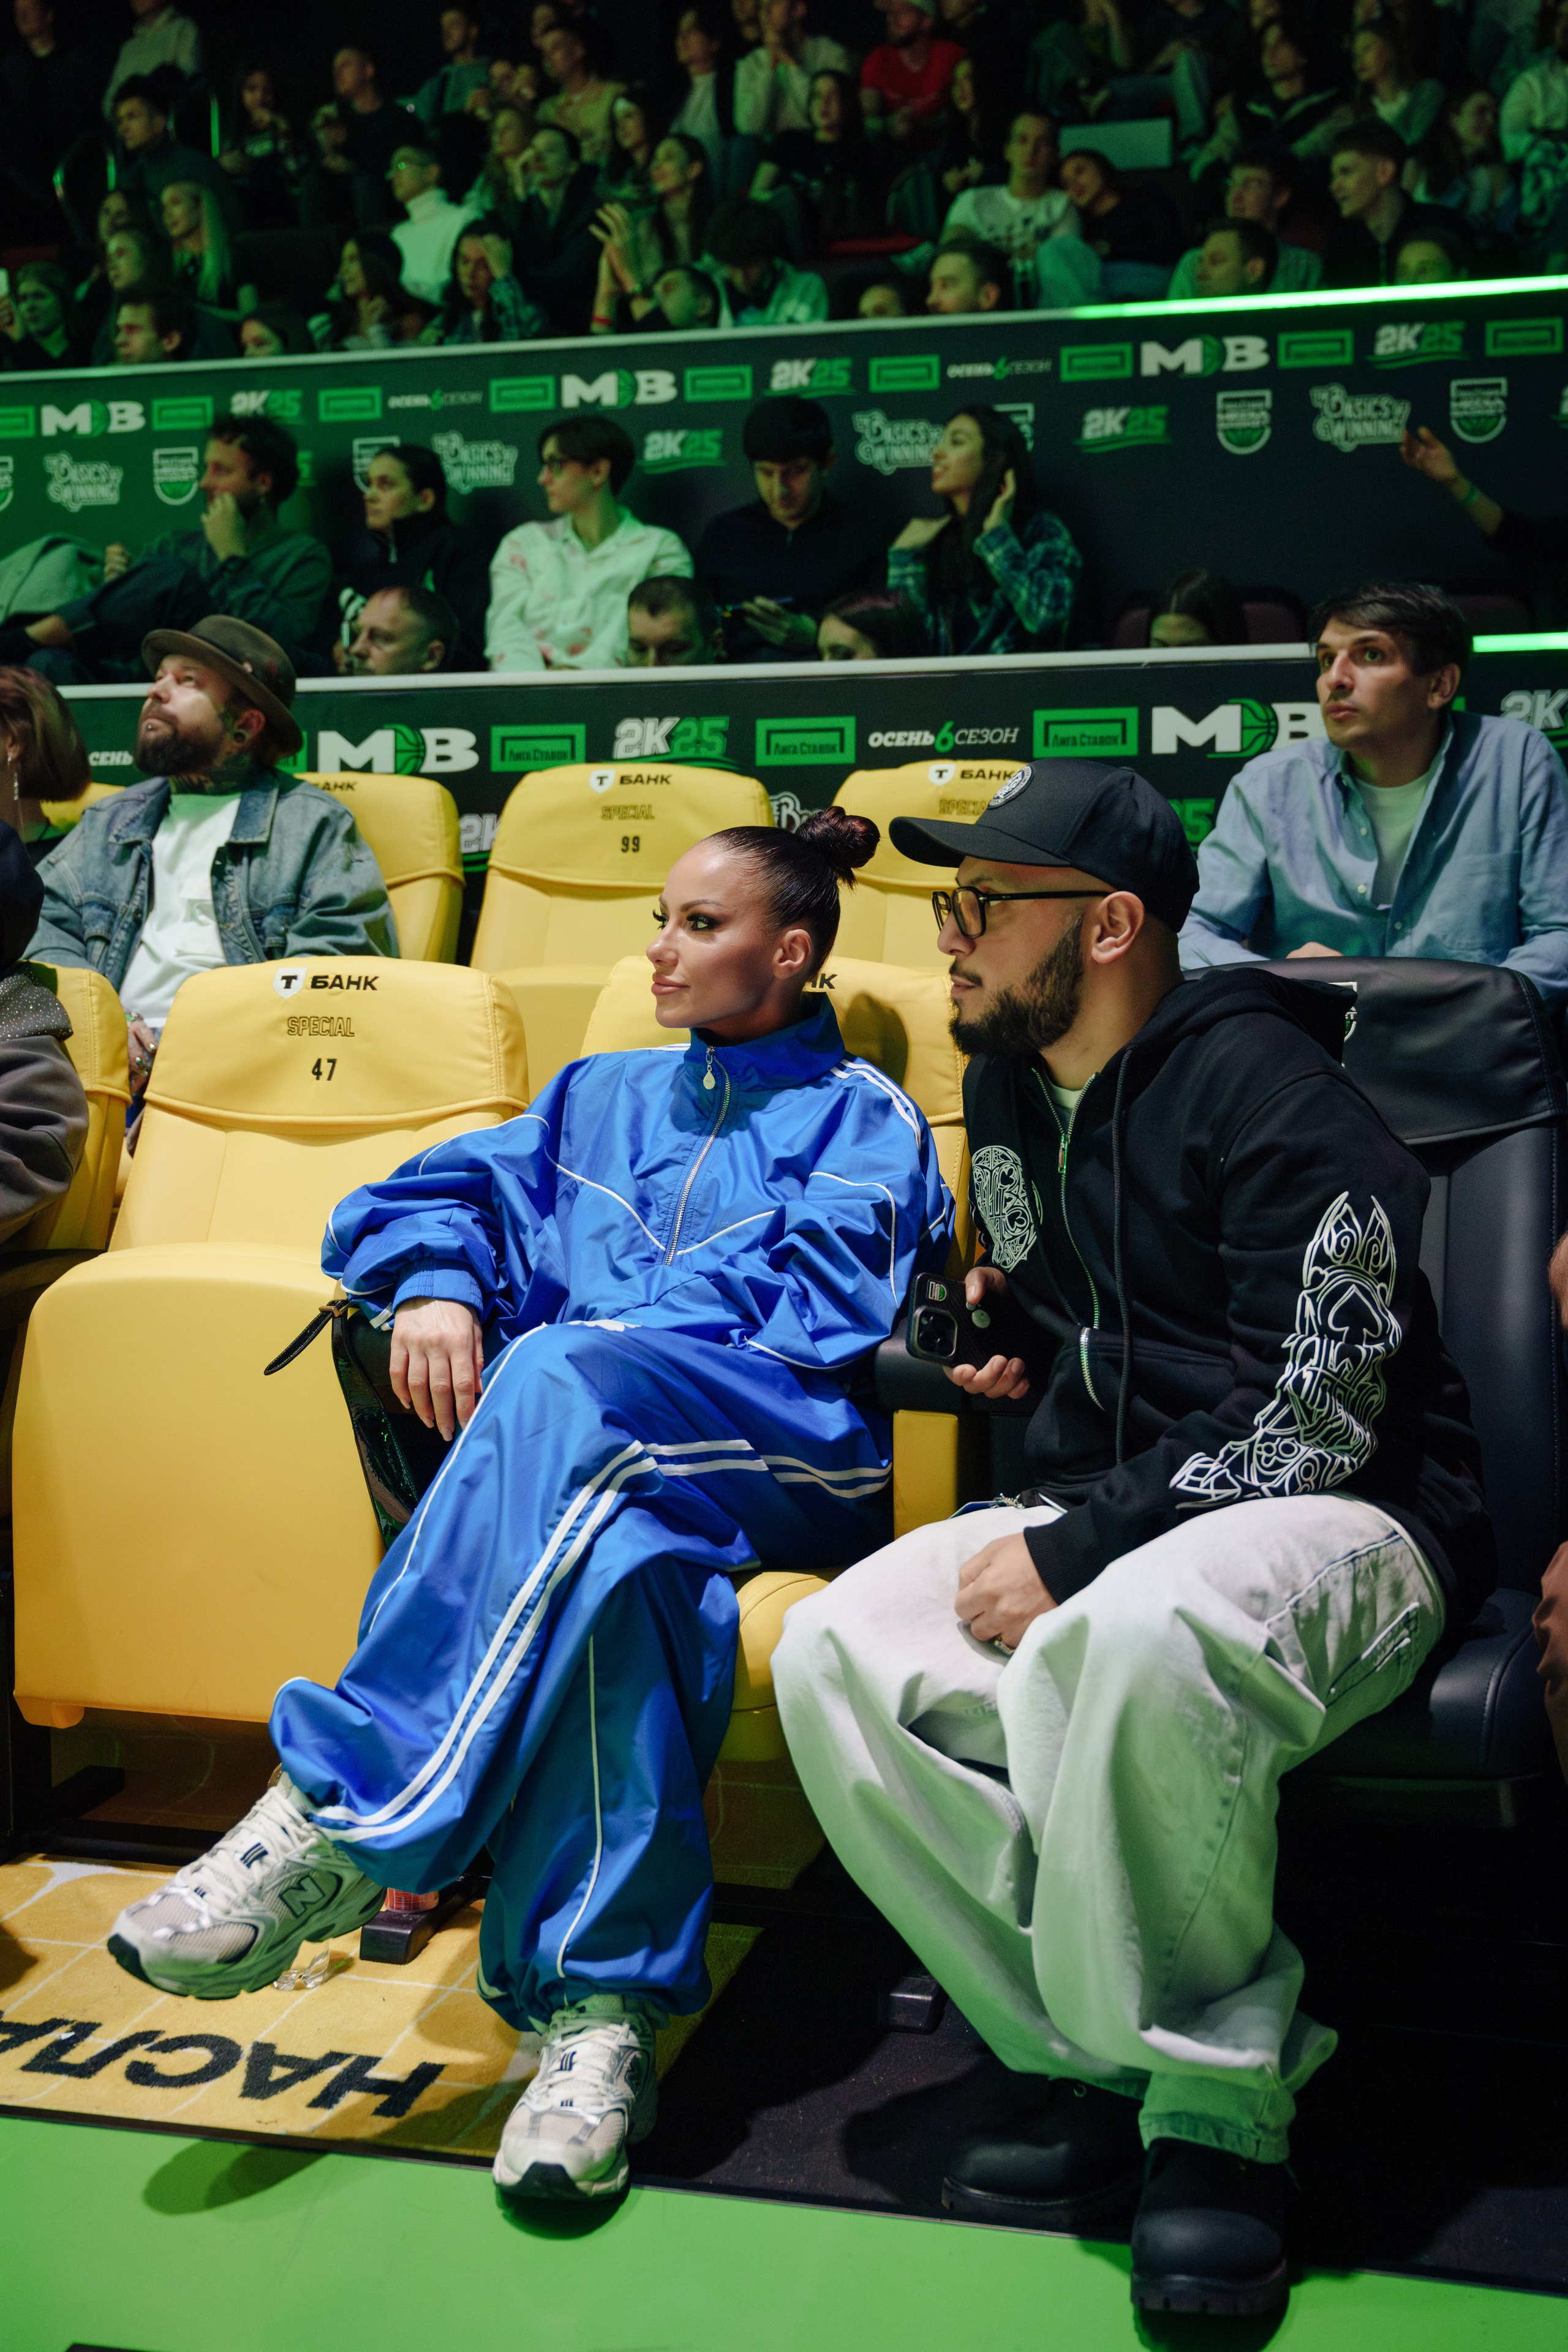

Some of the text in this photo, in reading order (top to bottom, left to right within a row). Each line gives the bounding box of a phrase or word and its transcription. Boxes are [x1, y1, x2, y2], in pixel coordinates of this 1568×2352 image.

[1374, 321, 1465, 356] 2K25
[771, 357, 853, 392] 2K25
[1082, 405, 1169, 440] 2K25
[644, 430, 723, 461] 2K25
[1500, 689, 1568, 729] 2K
[614, 716, 730, 760] 2K25
[868, 720, 1019, 753] ОСЕНЬ 6 СЕЗОН
[89, 750, 134, 766] СЕНЬ
[619, 774, 673, 785] БАНК
[960, 768, 1015, 780] БАНК
[313, 780, 357, 791] АНК
[601, 804, 655, 820] SPECIAL
[621, 835, 640, 853] 99
[311, 974, 380, 991] БАНК
[287, 1016, 355, 1038] SPECIAL
[311, 1058, 337, 1081] 47
